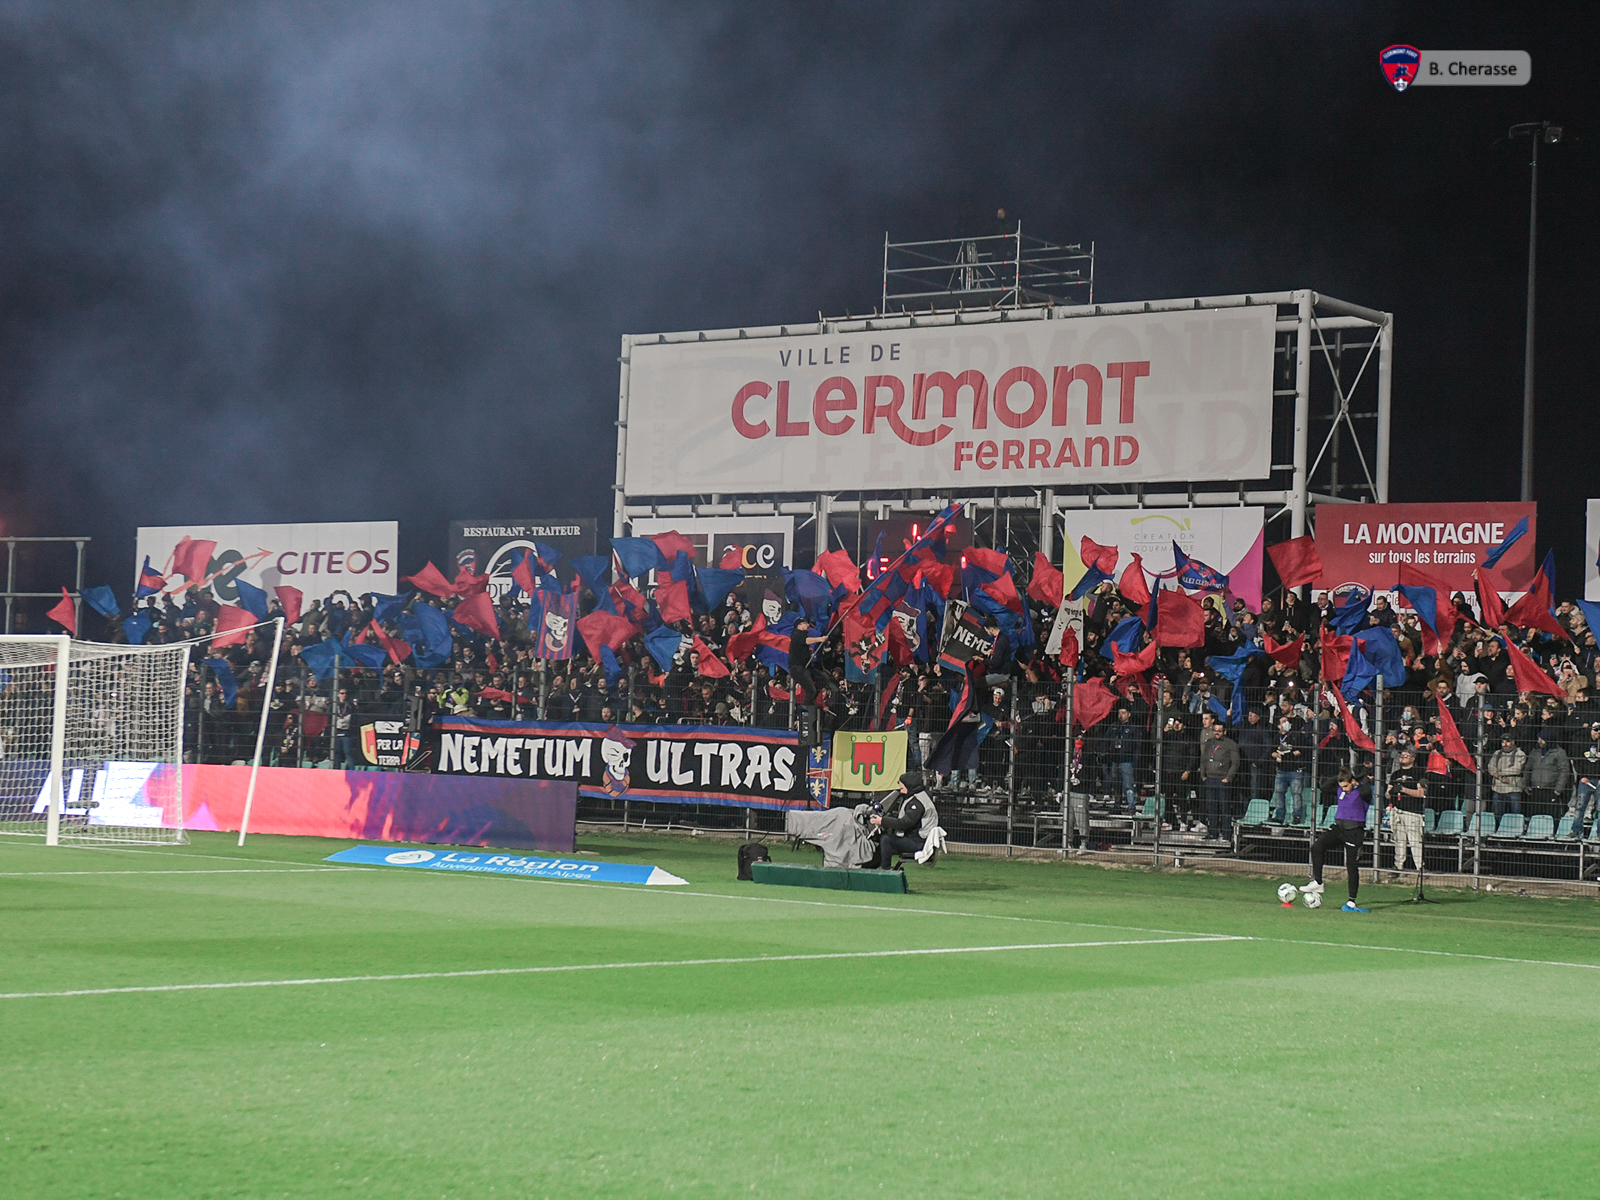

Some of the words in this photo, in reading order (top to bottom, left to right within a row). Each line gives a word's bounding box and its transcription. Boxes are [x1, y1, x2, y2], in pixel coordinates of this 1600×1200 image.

[779, 346, 850, 367] VILLE
[870, 343, 901, 362] DE
[463, 527, 525, 537] RESTAURANT
[532, 526, 581, 536] TRAITEUR
[1343, 523, 1371, 544] LA
[1376, 522, 1504, 544] MONTAGNE
[276, 549, 390, 575] CITEOS
[1369, 551, 1386, 564] sur
[1388, 550, 1411, 564] tous
[1414, 549, 1430, 564] les
[1433, 549, 1476, 564] terrains
[953, 626, 993, 657] NEME
[376, 739, 391, 750] PER
[392, 740, 403, 750] LA
[438, 733, 593, 778] NEMETUM
[645, 740, 796, 793] ULTRAS
[441, 853, 480, 864] La
[485, 855, 600, 871] Région
